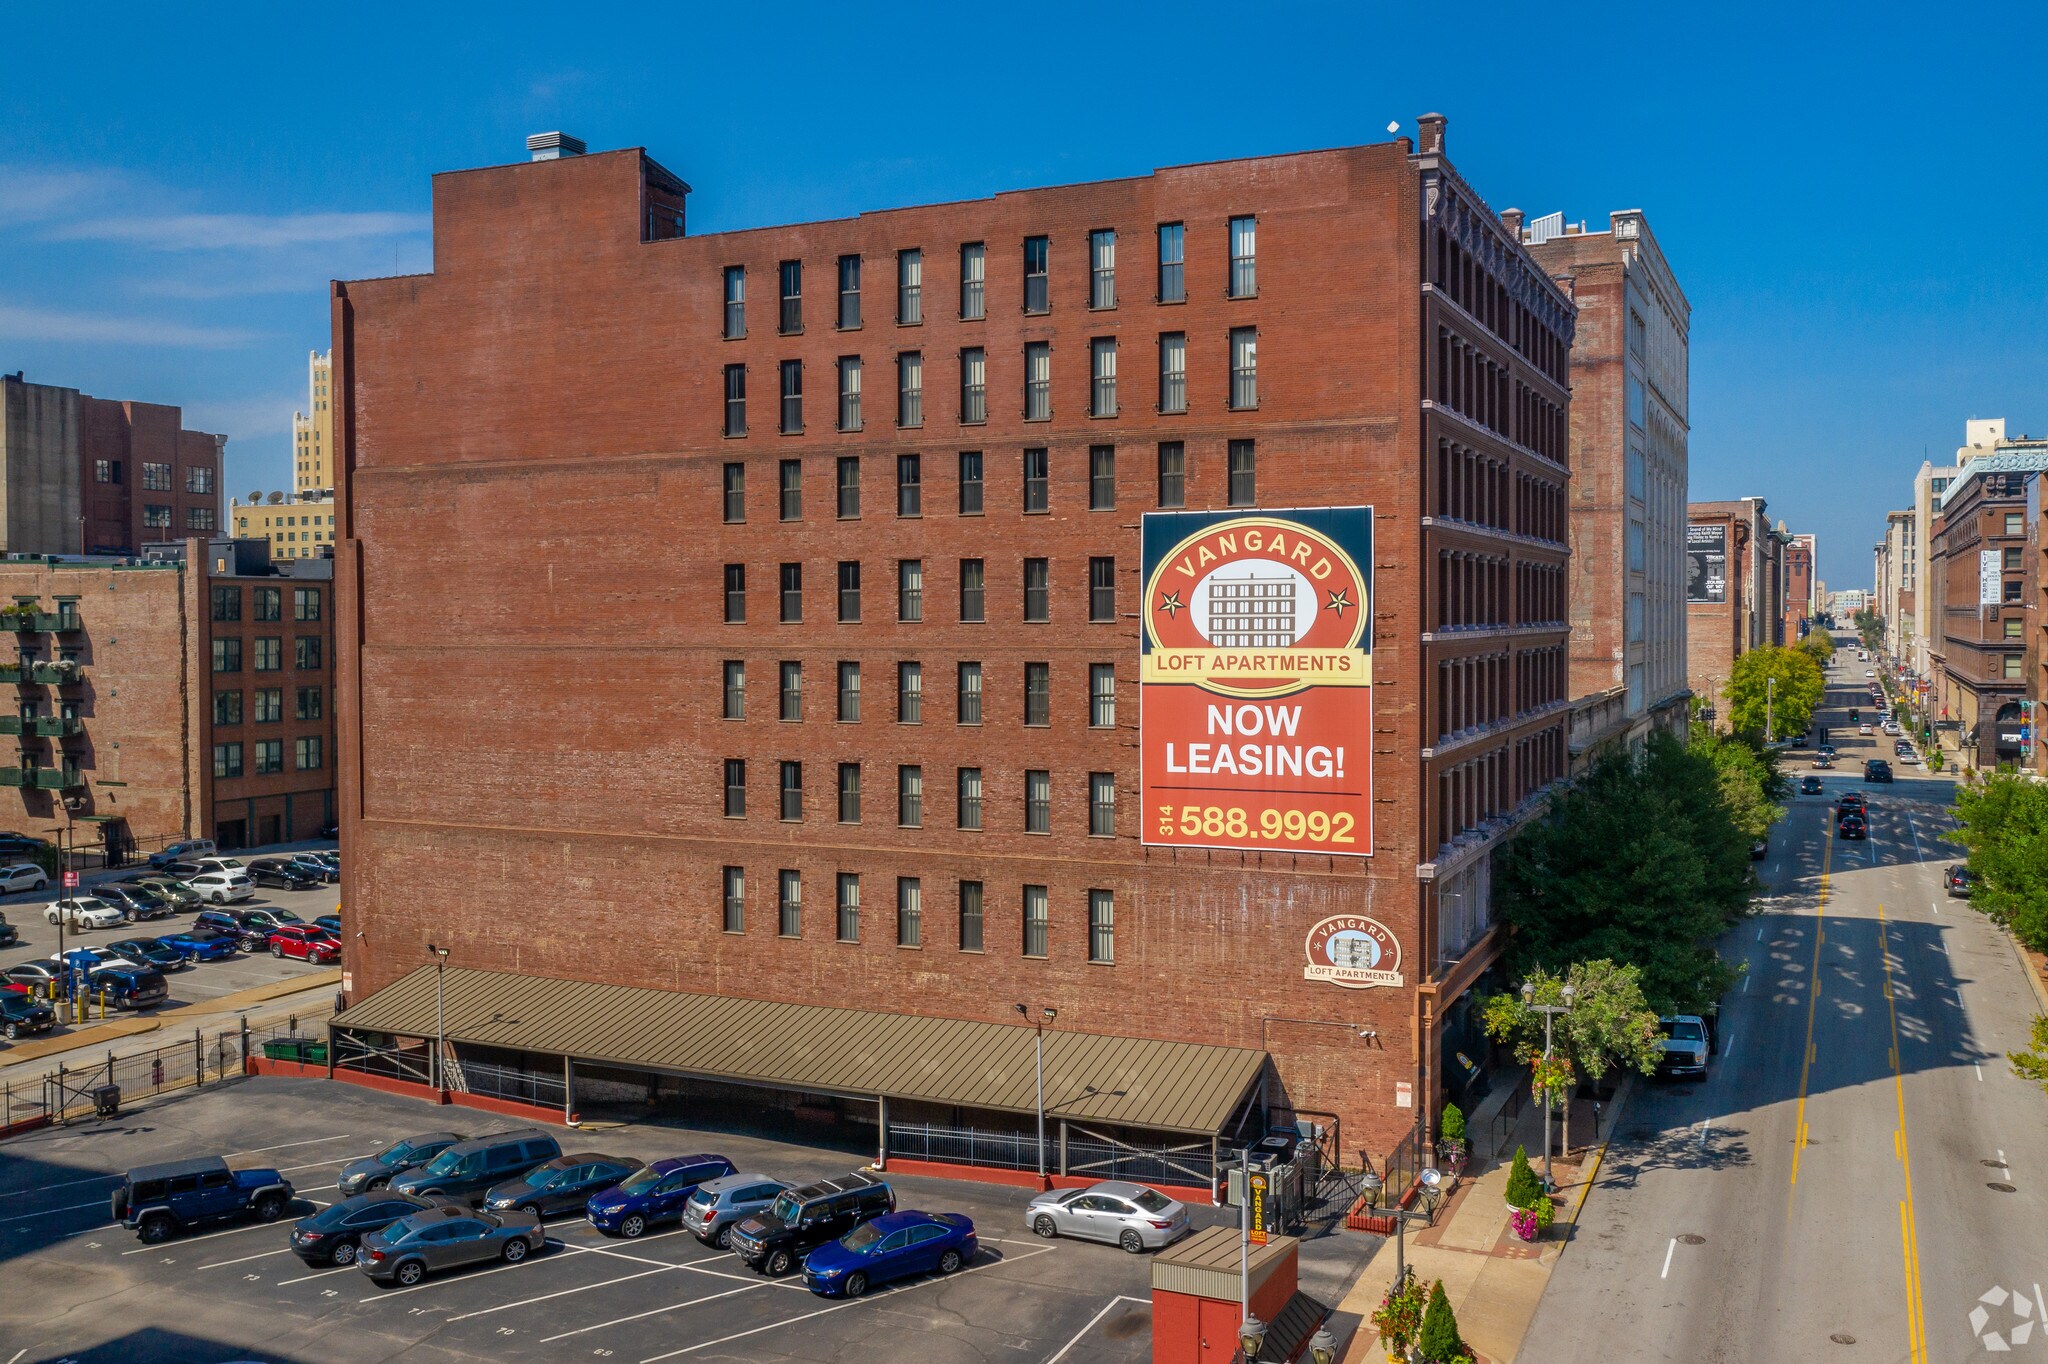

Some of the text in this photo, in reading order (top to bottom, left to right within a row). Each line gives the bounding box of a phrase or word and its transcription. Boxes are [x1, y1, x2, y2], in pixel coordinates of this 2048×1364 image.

[1175, 530, 1333, 581] VANGARD
[1157, 655, 1351, 672] LOFT APARTMENTS
[1207, 704, 1302, 737] NOW
[1166, 742, 1345, 778] LEASING!
[1159, 804, 1174, 836] 314
[1179, 805, 1355, 844] 588.9992
[1319, 919, 1386, 942] VANGARD
[1310, 968, 1396, 981] LOFT APARTMENTS
[1254, 1189, 1262, 1231] VANGARD
[496, 1327, 515, 1335] 70
[593, 1348, 614, 1357] 69
